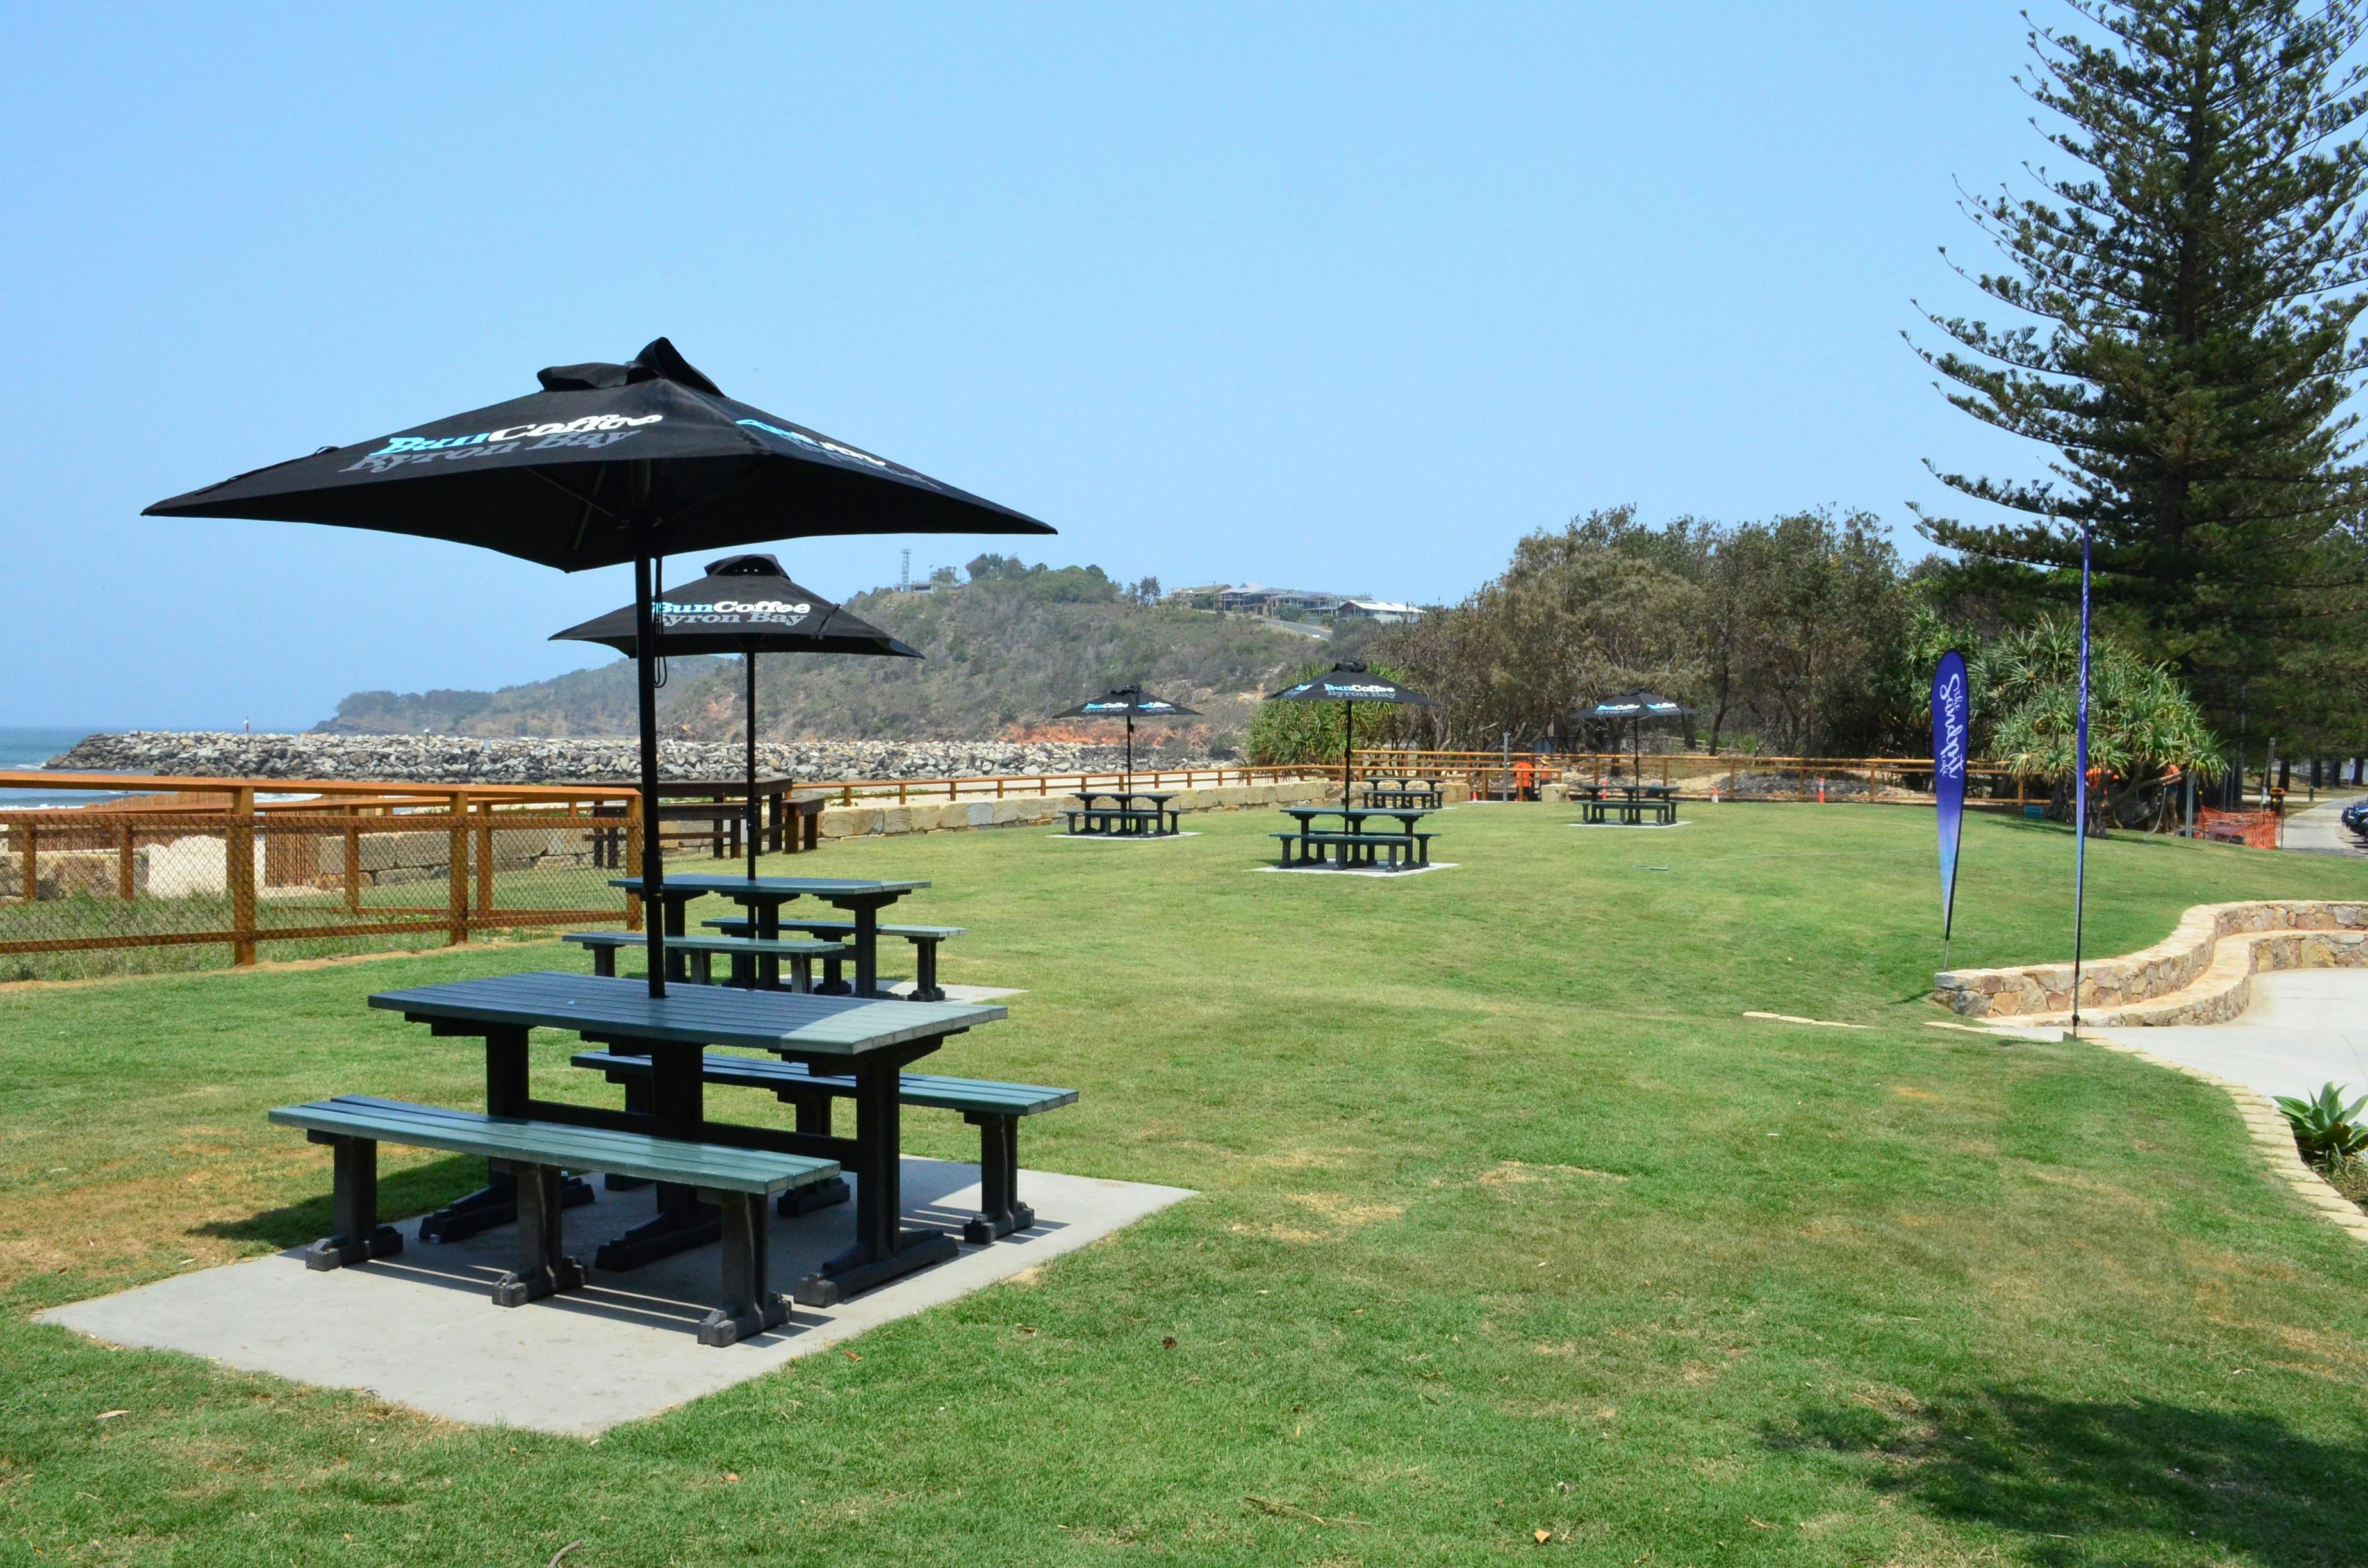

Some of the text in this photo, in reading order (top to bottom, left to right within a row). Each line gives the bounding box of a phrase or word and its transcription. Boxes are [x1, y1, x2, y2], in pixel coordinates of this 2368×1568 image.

[368, 414, 663, 456] BunCoffee
[338, 430, 643, 473] Byron Bay
[651, 601, 811, 614] BunCoffee
[746, 612, 807, 626] Bay
[1323, 683, 1395, 693] BunCoffee
[1939, 673, 1964, 778] Sandpit
